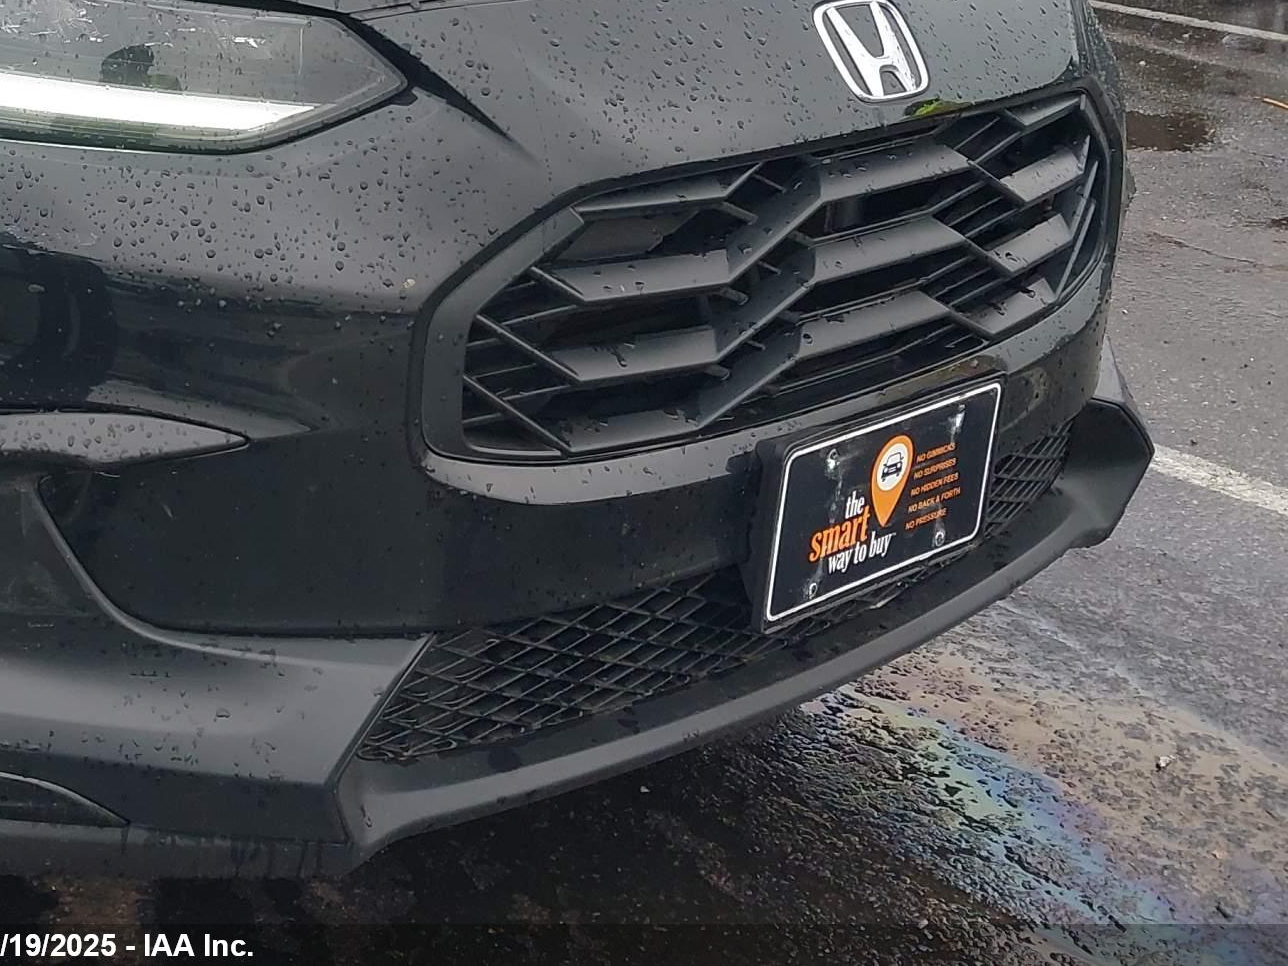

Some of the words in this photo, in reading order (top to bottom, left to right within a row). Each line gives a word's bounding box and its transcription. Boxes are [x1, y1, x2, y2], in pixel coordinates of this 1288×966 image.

[914, 470, 924, 480] NO
[924, 457, 957, 475] SURPRISES
[916, 454, 926, 464] NO
[911, 487, 921, 497] NO
[921, 478, 943, 493] HIDDEN
[943, 472, 959, 485] FEES
[845, 490, 865, 519] the
[907, 504, 918, 514] NO
[918, 497, 935, 511] BACK
[941, 486, 961, 501] FORTH
[809, 505, 870, 562] smart
[905, 521, 915, 531] NO
[828, 548, 853, 574] way
[853, 541, 867, 564] to
[869, 530, 892, 558] buy
